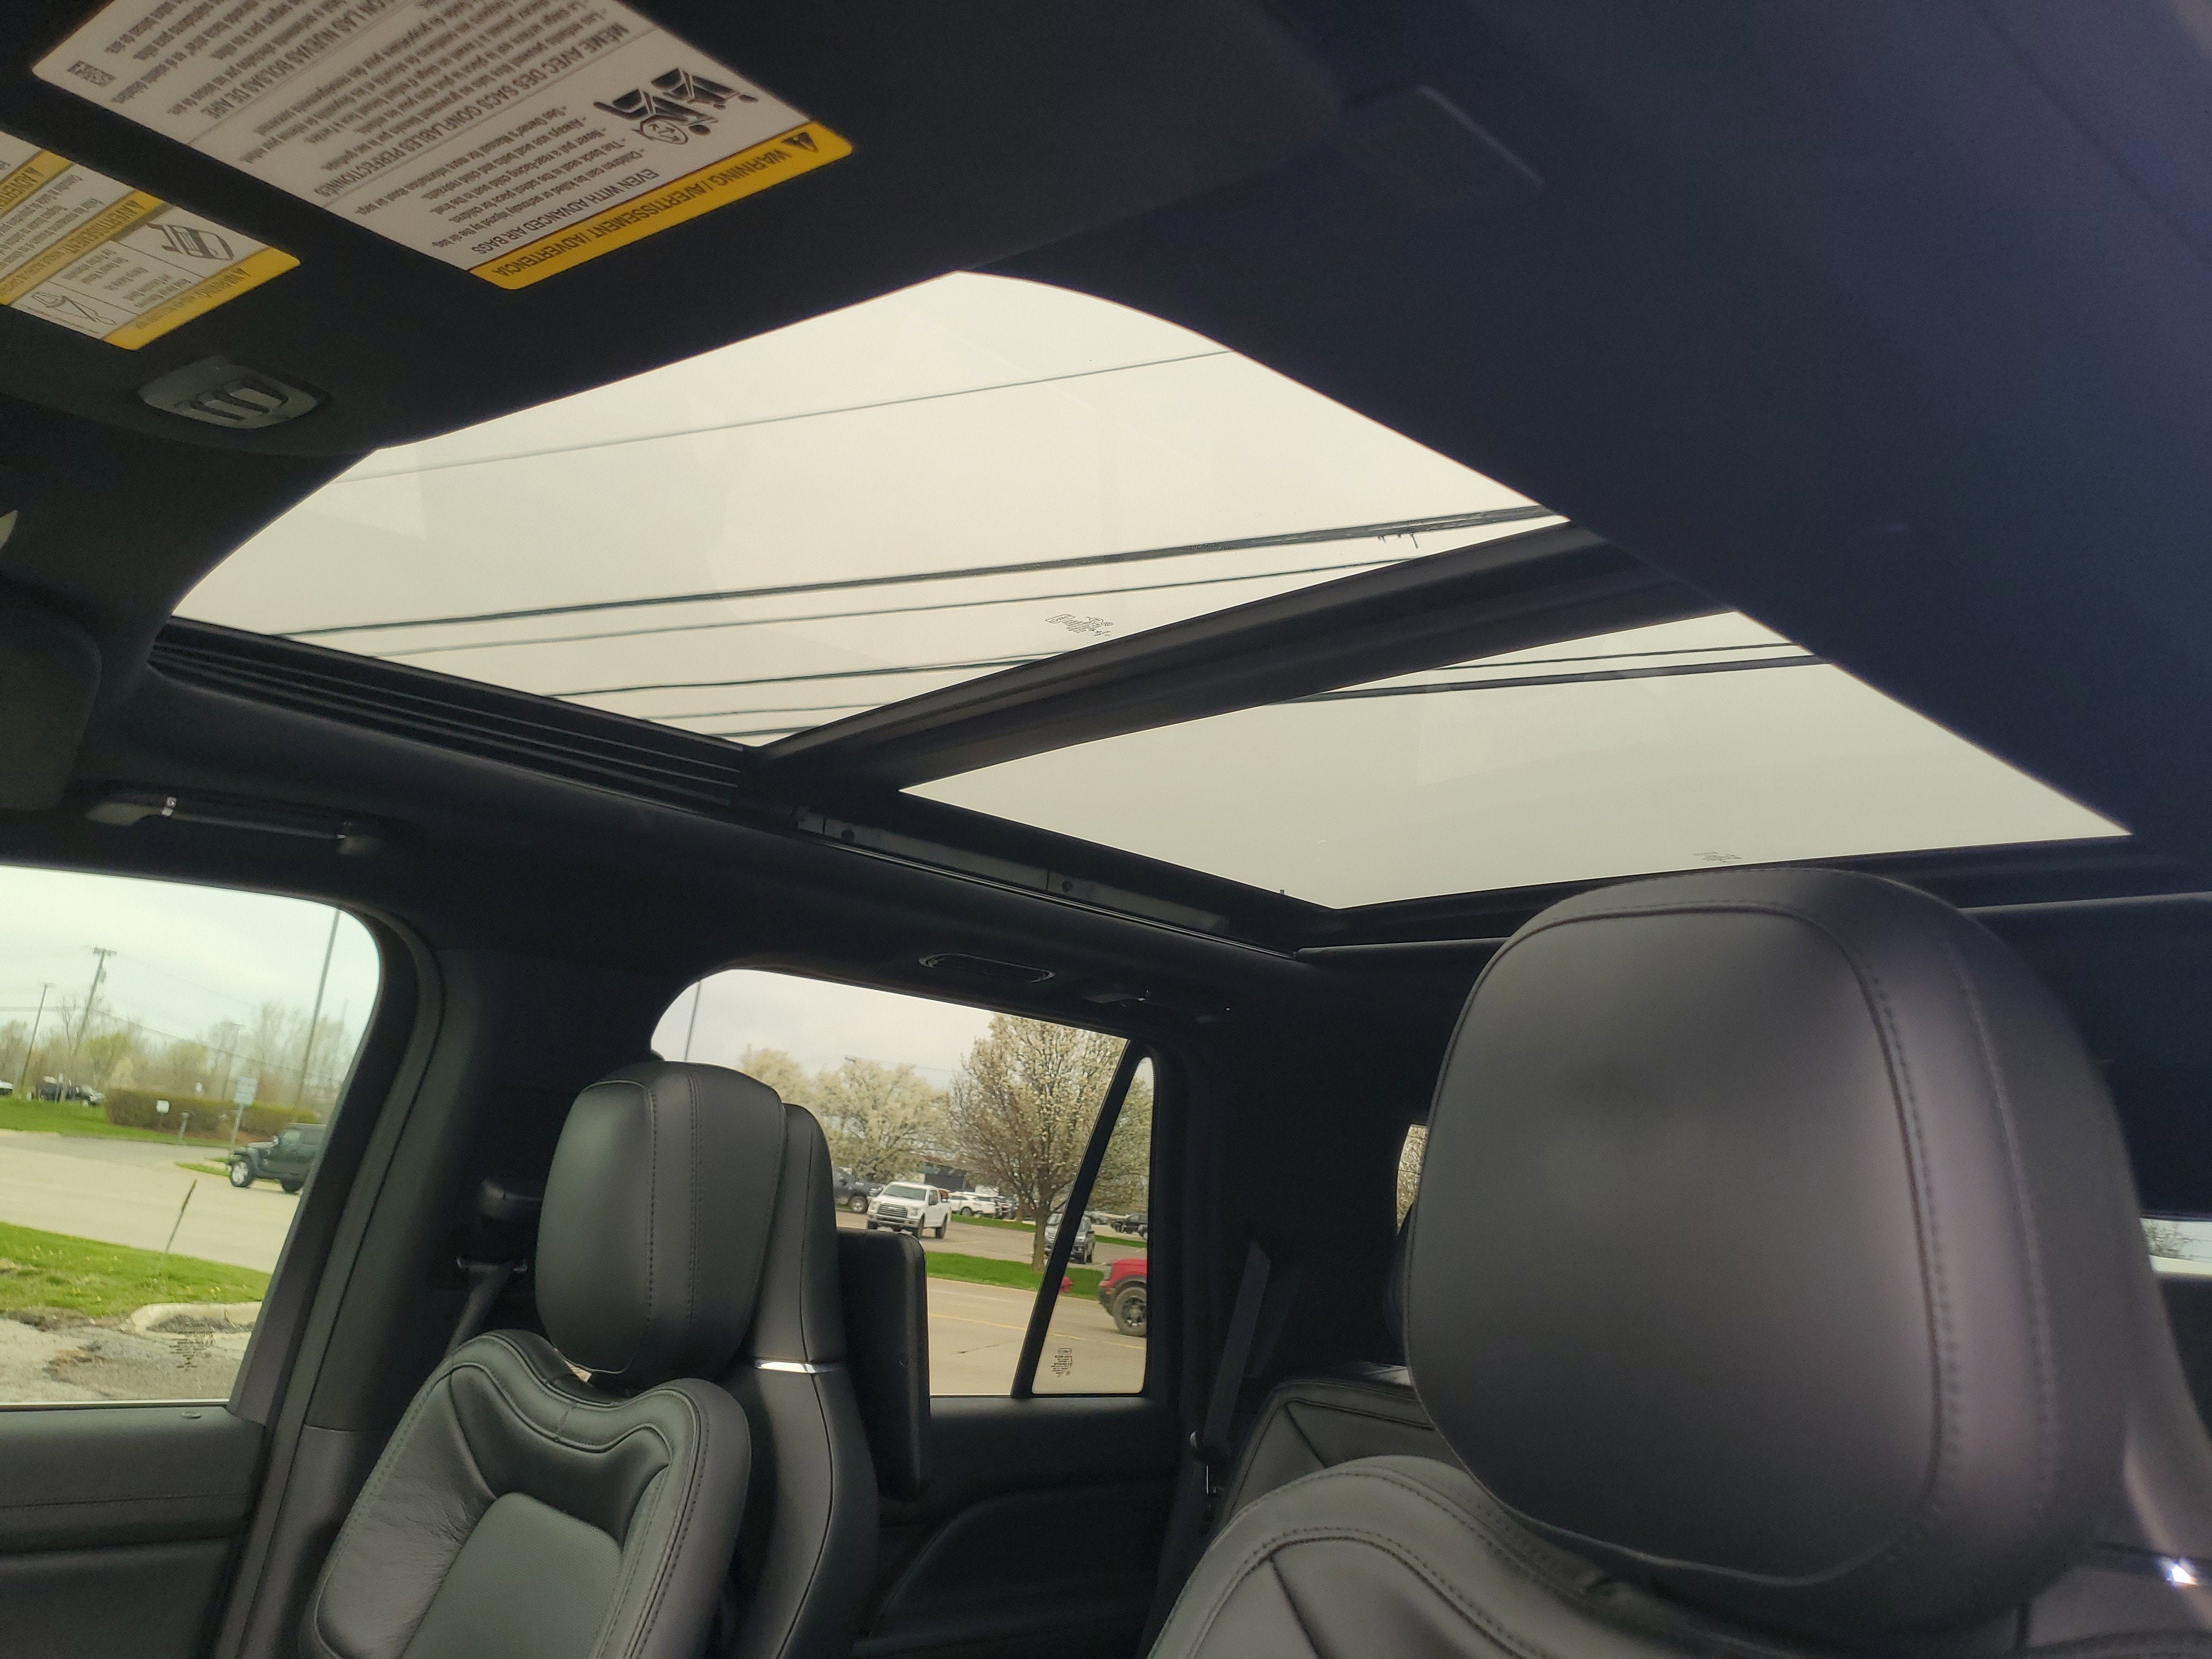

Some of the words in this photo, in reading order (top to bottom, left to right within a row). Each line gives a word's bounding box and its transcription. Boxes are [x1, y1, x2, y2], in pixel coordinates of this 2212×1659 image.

[537, 46, 589, 75] AVEC
[509, 67, 549, 91] DES
[223, 87, 253, 104] DE
[472, 83, 521, 110] SACS
[395, 103, 484, 152] GONFLABLES
[573, 129, 605, 146] Never
[554, 140, 580, 154] put
[600, 140, 624, 153] The
[600, 150, 644, 172] Children
[705, 148, 792, 187] WARNING
[536, 172, 557, 183] the
[550, 168, 567, 176] is
[572, 174, 591, 184] be
[583, 167, 606, 178] can
[616, 168, 661, 189] EVEN
[539, 190, 555, 199] or
[549, 180, 580, 195] killed
[583, 184, 625, 204] WITH
[448, 196, 470, 207] the
[461, 192, 478, 200] in
[479, 200, 498, 210] for
[520, 198, 593, 232] ADVANCED
[456, 227, 478, 238] the
[467, 222, 488, 232] by
[500, 226, 531, 241] AIR
[447, 233, 466, 242] air
[468, 235, 511, 255] BAGS
